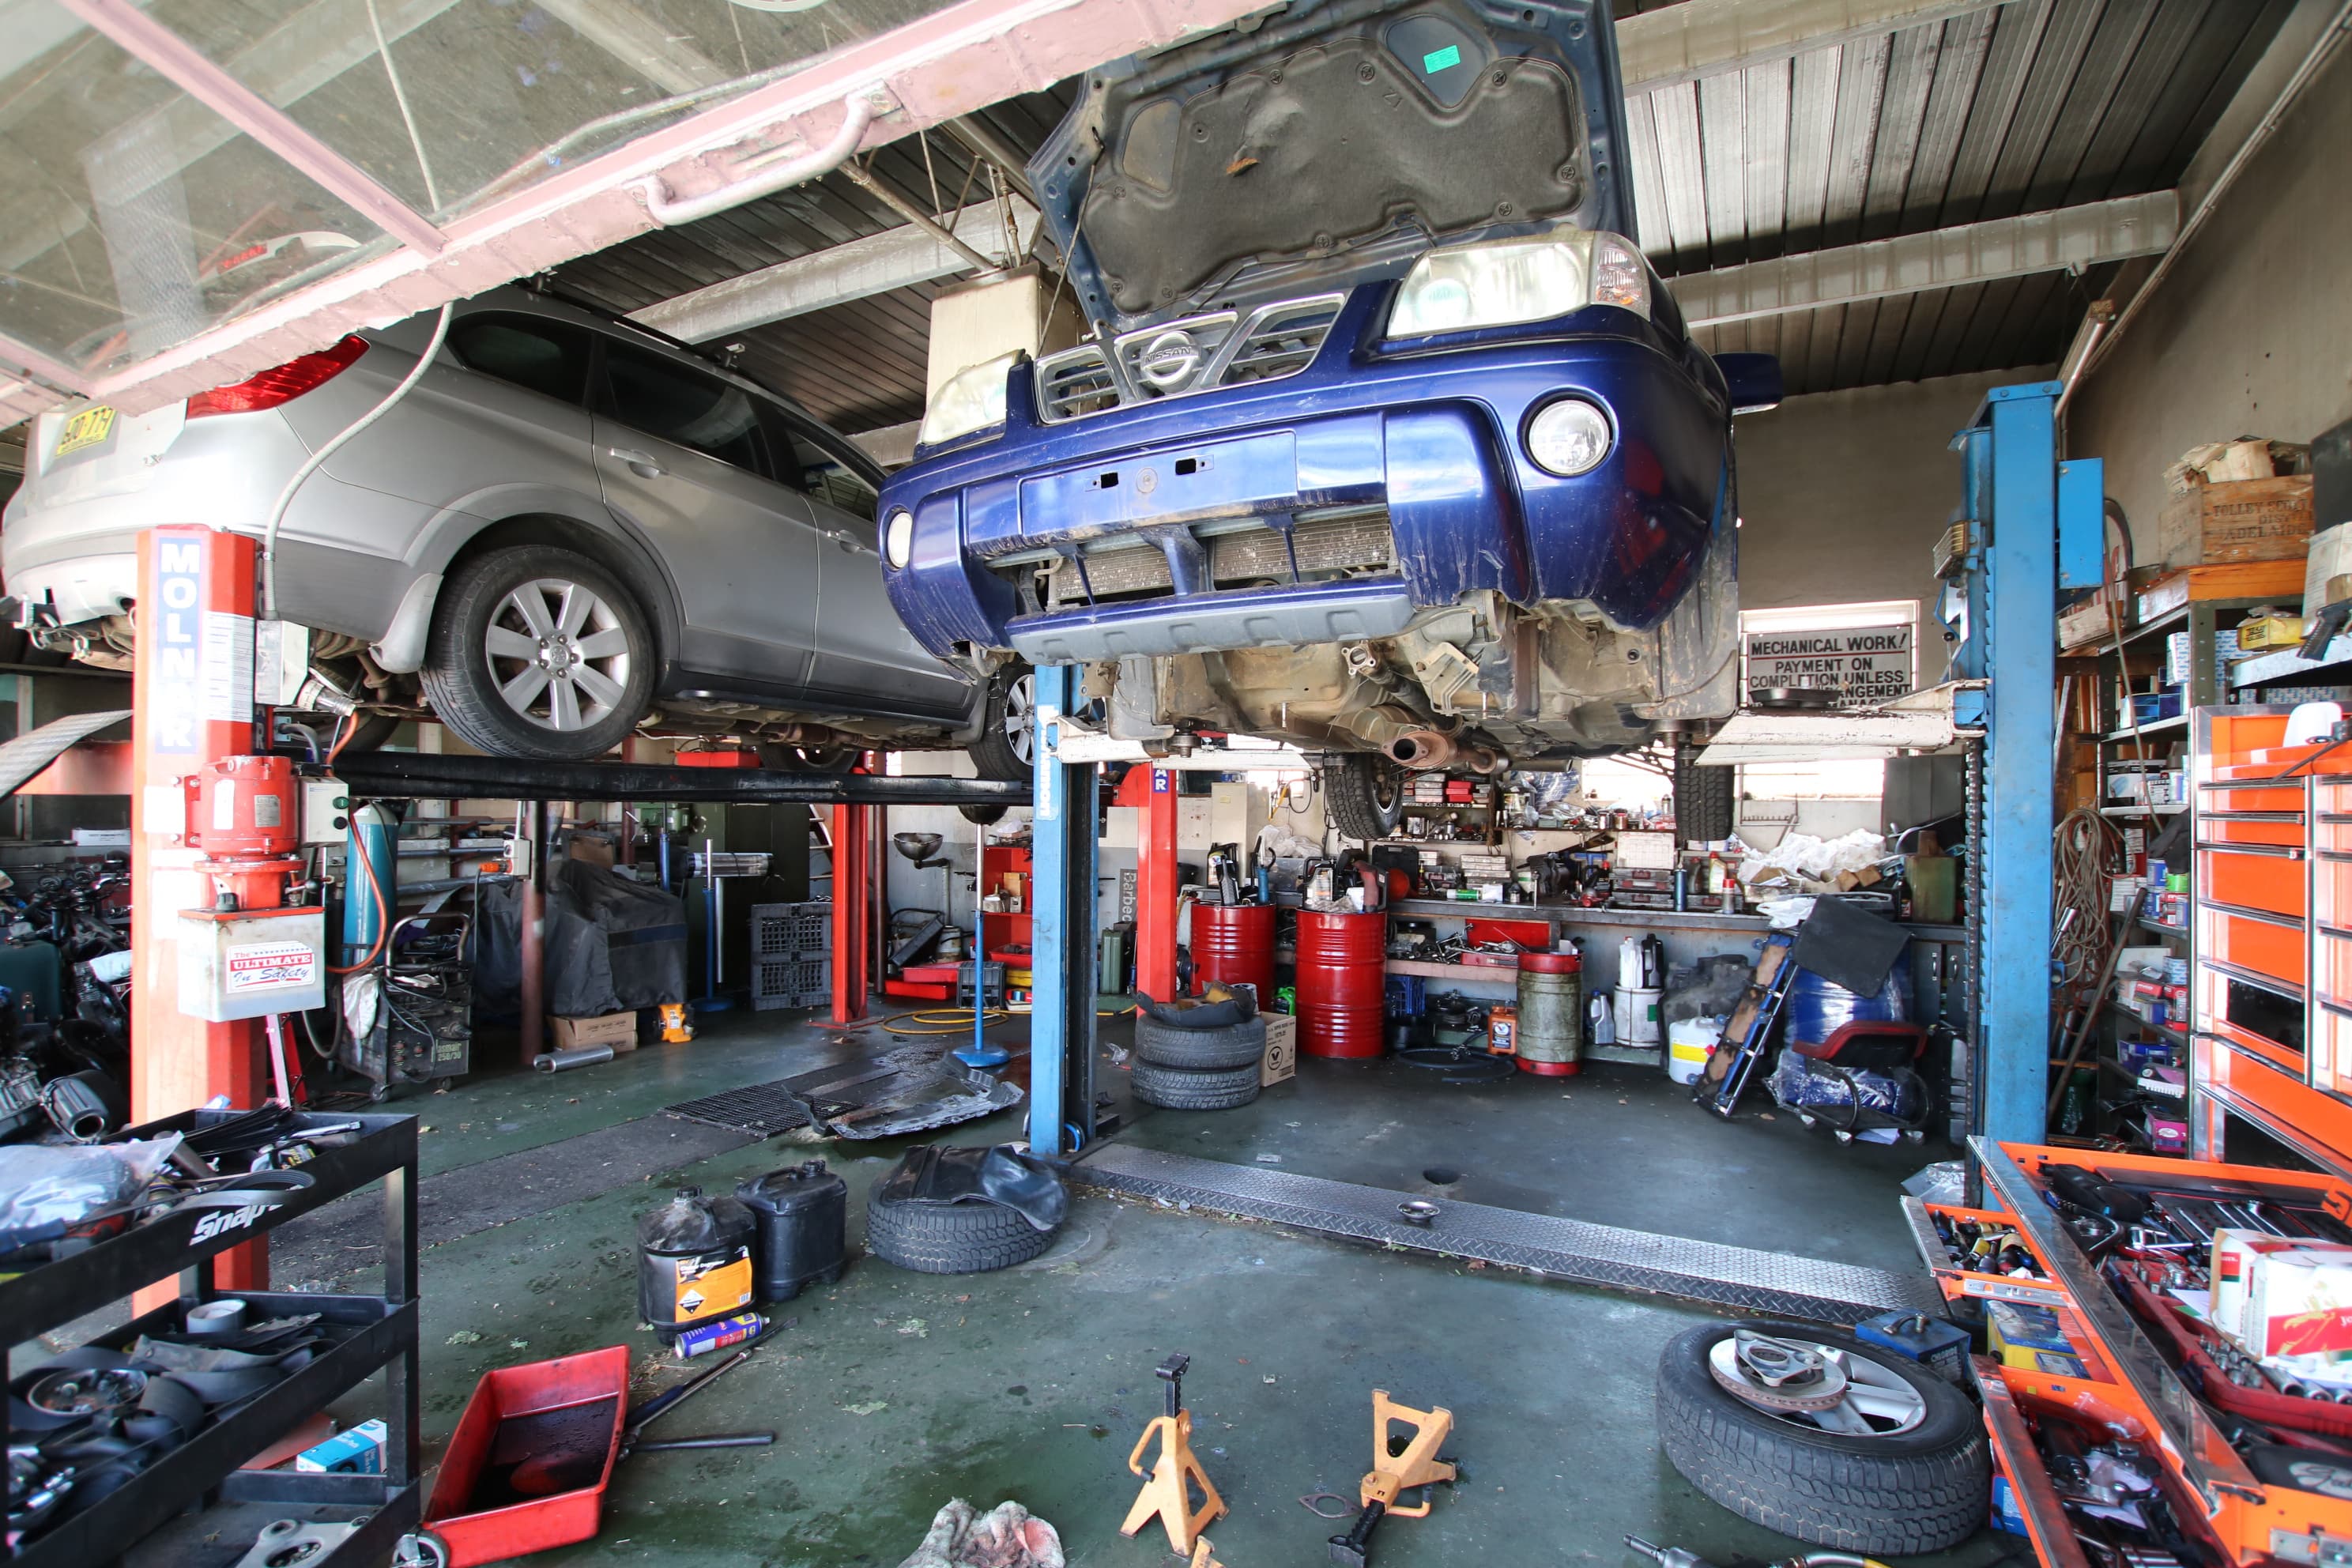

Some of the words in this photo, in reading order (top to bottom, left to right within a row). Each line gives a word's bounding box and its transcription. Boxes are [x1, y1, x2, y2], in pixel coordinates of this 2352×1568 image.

[1144, 346, 1192, 364] NISSAN
[160, 543, 201, 747] MOLNAR
[1751, 639, 1842, 655] MECHANICAL
[1847, 633, 1907, 651] WORK!
[1775, 659, 1843, 673] PAYMENT
[1852, 658, 1872, 671] ON
[1845, 670, 1904, 684] UNLESS
[233, 955, 311, 969] ULTIMATE
[259, 967, 310, 981] Safety
